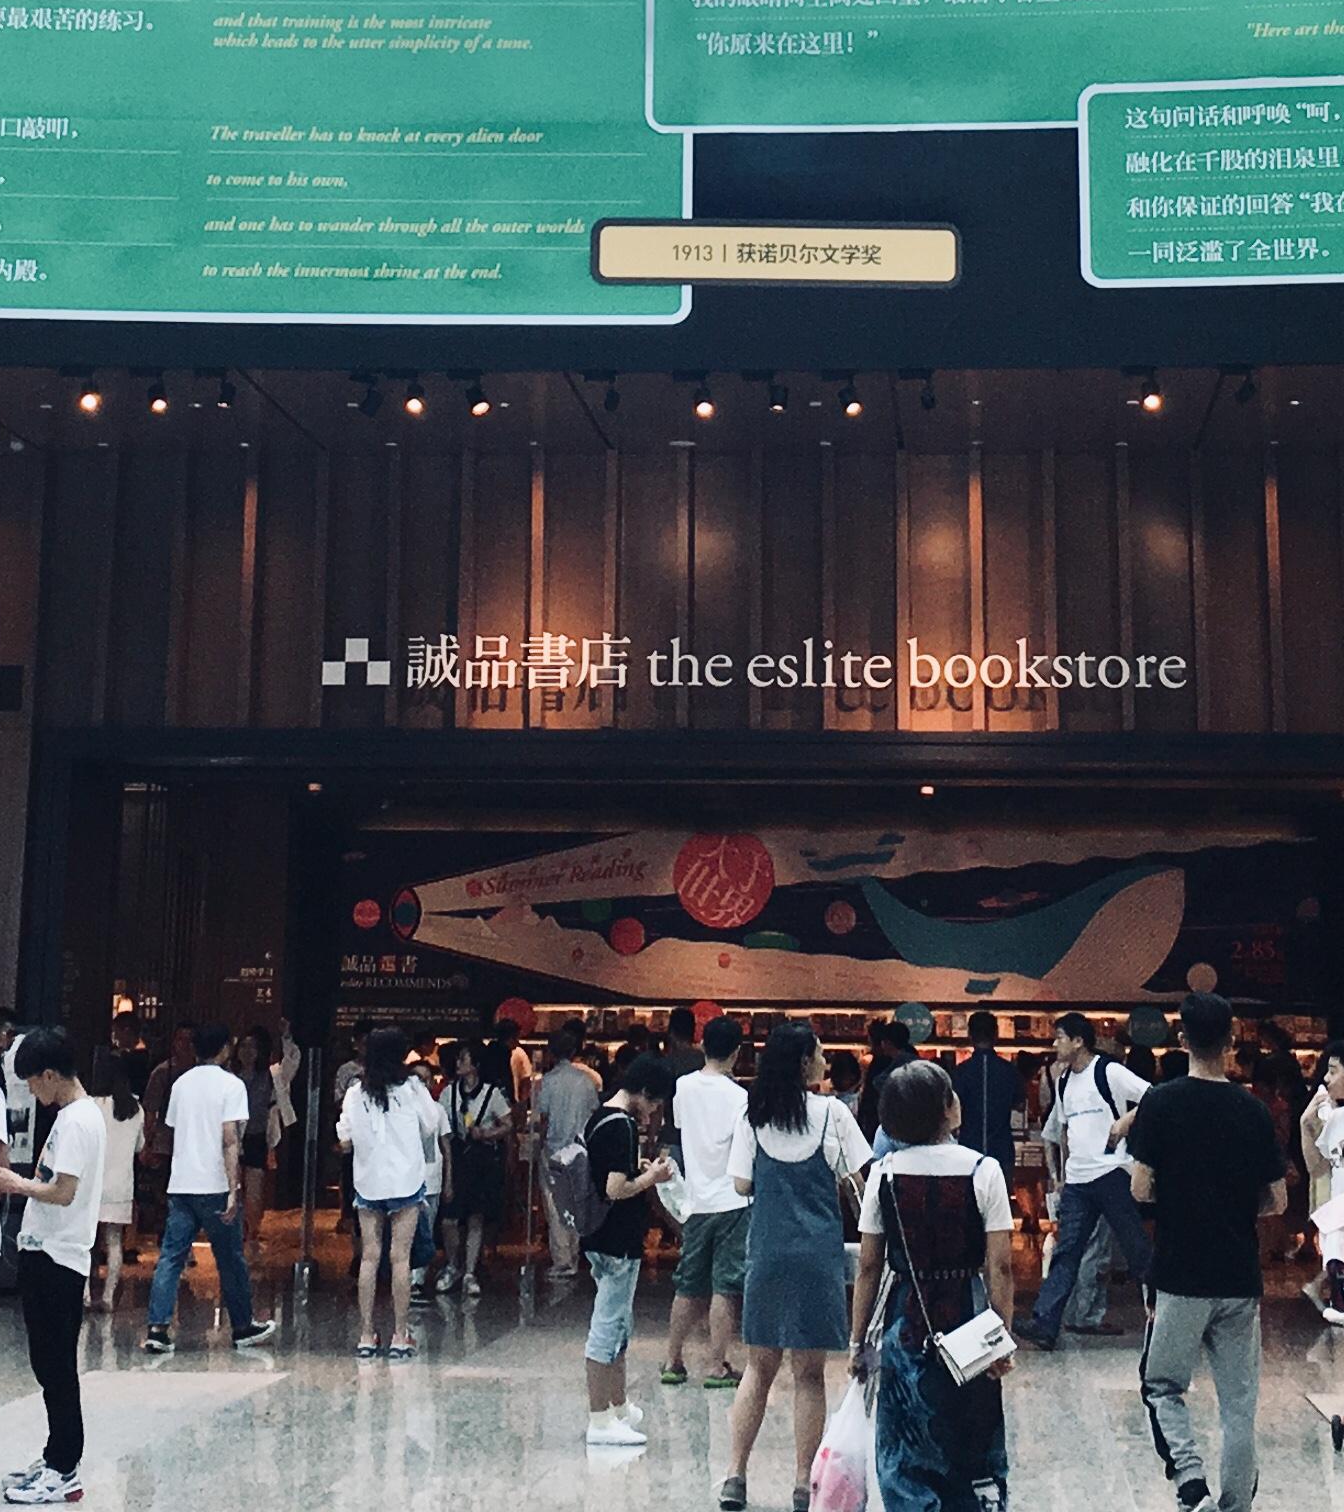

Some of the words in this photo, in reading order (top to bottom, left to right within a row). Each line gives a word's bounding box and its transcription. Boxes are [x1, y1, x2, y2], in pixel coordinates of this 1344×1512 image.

[212, 11, 245, 27] and
[246, 11, 278, 28] that
[281, 14, 344, 33] training
[346, 14, 359, 28] is
[362, 13, 386, 29] the
[389, 18, 424, 29] most
[427, 15, 492, 29] intricate
[1293, 23, 1319, 36] art
[212, 31, 258, 47] which
[260, 32, 299, 48] leads
[302, 36, 318, 48] to
[320, 33, 345, 49] the
[348, 37, 385, 49] utter
[388, 33, 460, 53] simplicity
[463, 33, 483, 53] of
[481, 38, 492, 49] a
[495, 38, 532, 49] tune.
[210, 124, 239, 141] The
[241, 124, 306, 141] traveller
[307, 125, 334, 142] has
[337, 130, 353, 142] to
[355, 126, 401, 143] knock
[403, 131, 421, 142] at
[423, 132, 464, 147] every
[466, 127, 504, 143] alien
[507, 127, 543, 142] door
[205, 174, 222, 185] to
[225, 175, 265, 186] come
[267, 174, 283, 186] to
[285, 170, 309, 186] his
[311, 175, 348, 188] own,
[203, 215, 236, 231] and
[237, 220, 265, 231] one
[267, 215, 294, 231] has
[297, 220, 313, 231] to
[316, 216, 375, 232] wander
[377, 215, 437, 237] through
[439, 217, 463, 233] all
[464, 217, 489, 233] the
[491, 221, 532, 233] outer
[535, 217, 585, 233] worlds
[671, 245, 712, 261] 1913
[737, 243, 881, 264] 获诺贝尔文学奖
[201, 264, 218, 276] to
[220, 261, 262, 277] reach
[265, 261, 290, 277] the
[293, 262, 369, 277] innermost
[373, 262, 420, 279] shrine
[422, 266, 440, 279] at
[443, 262, 468, 279] the
[470, 262, 501, 279] end.
[407, 633, 630, 690] 誠品書店
[647, 638, 734, 688] the
[747, 638, 893, 689] eslite
[907, 638, 1188, 689] bookstore
